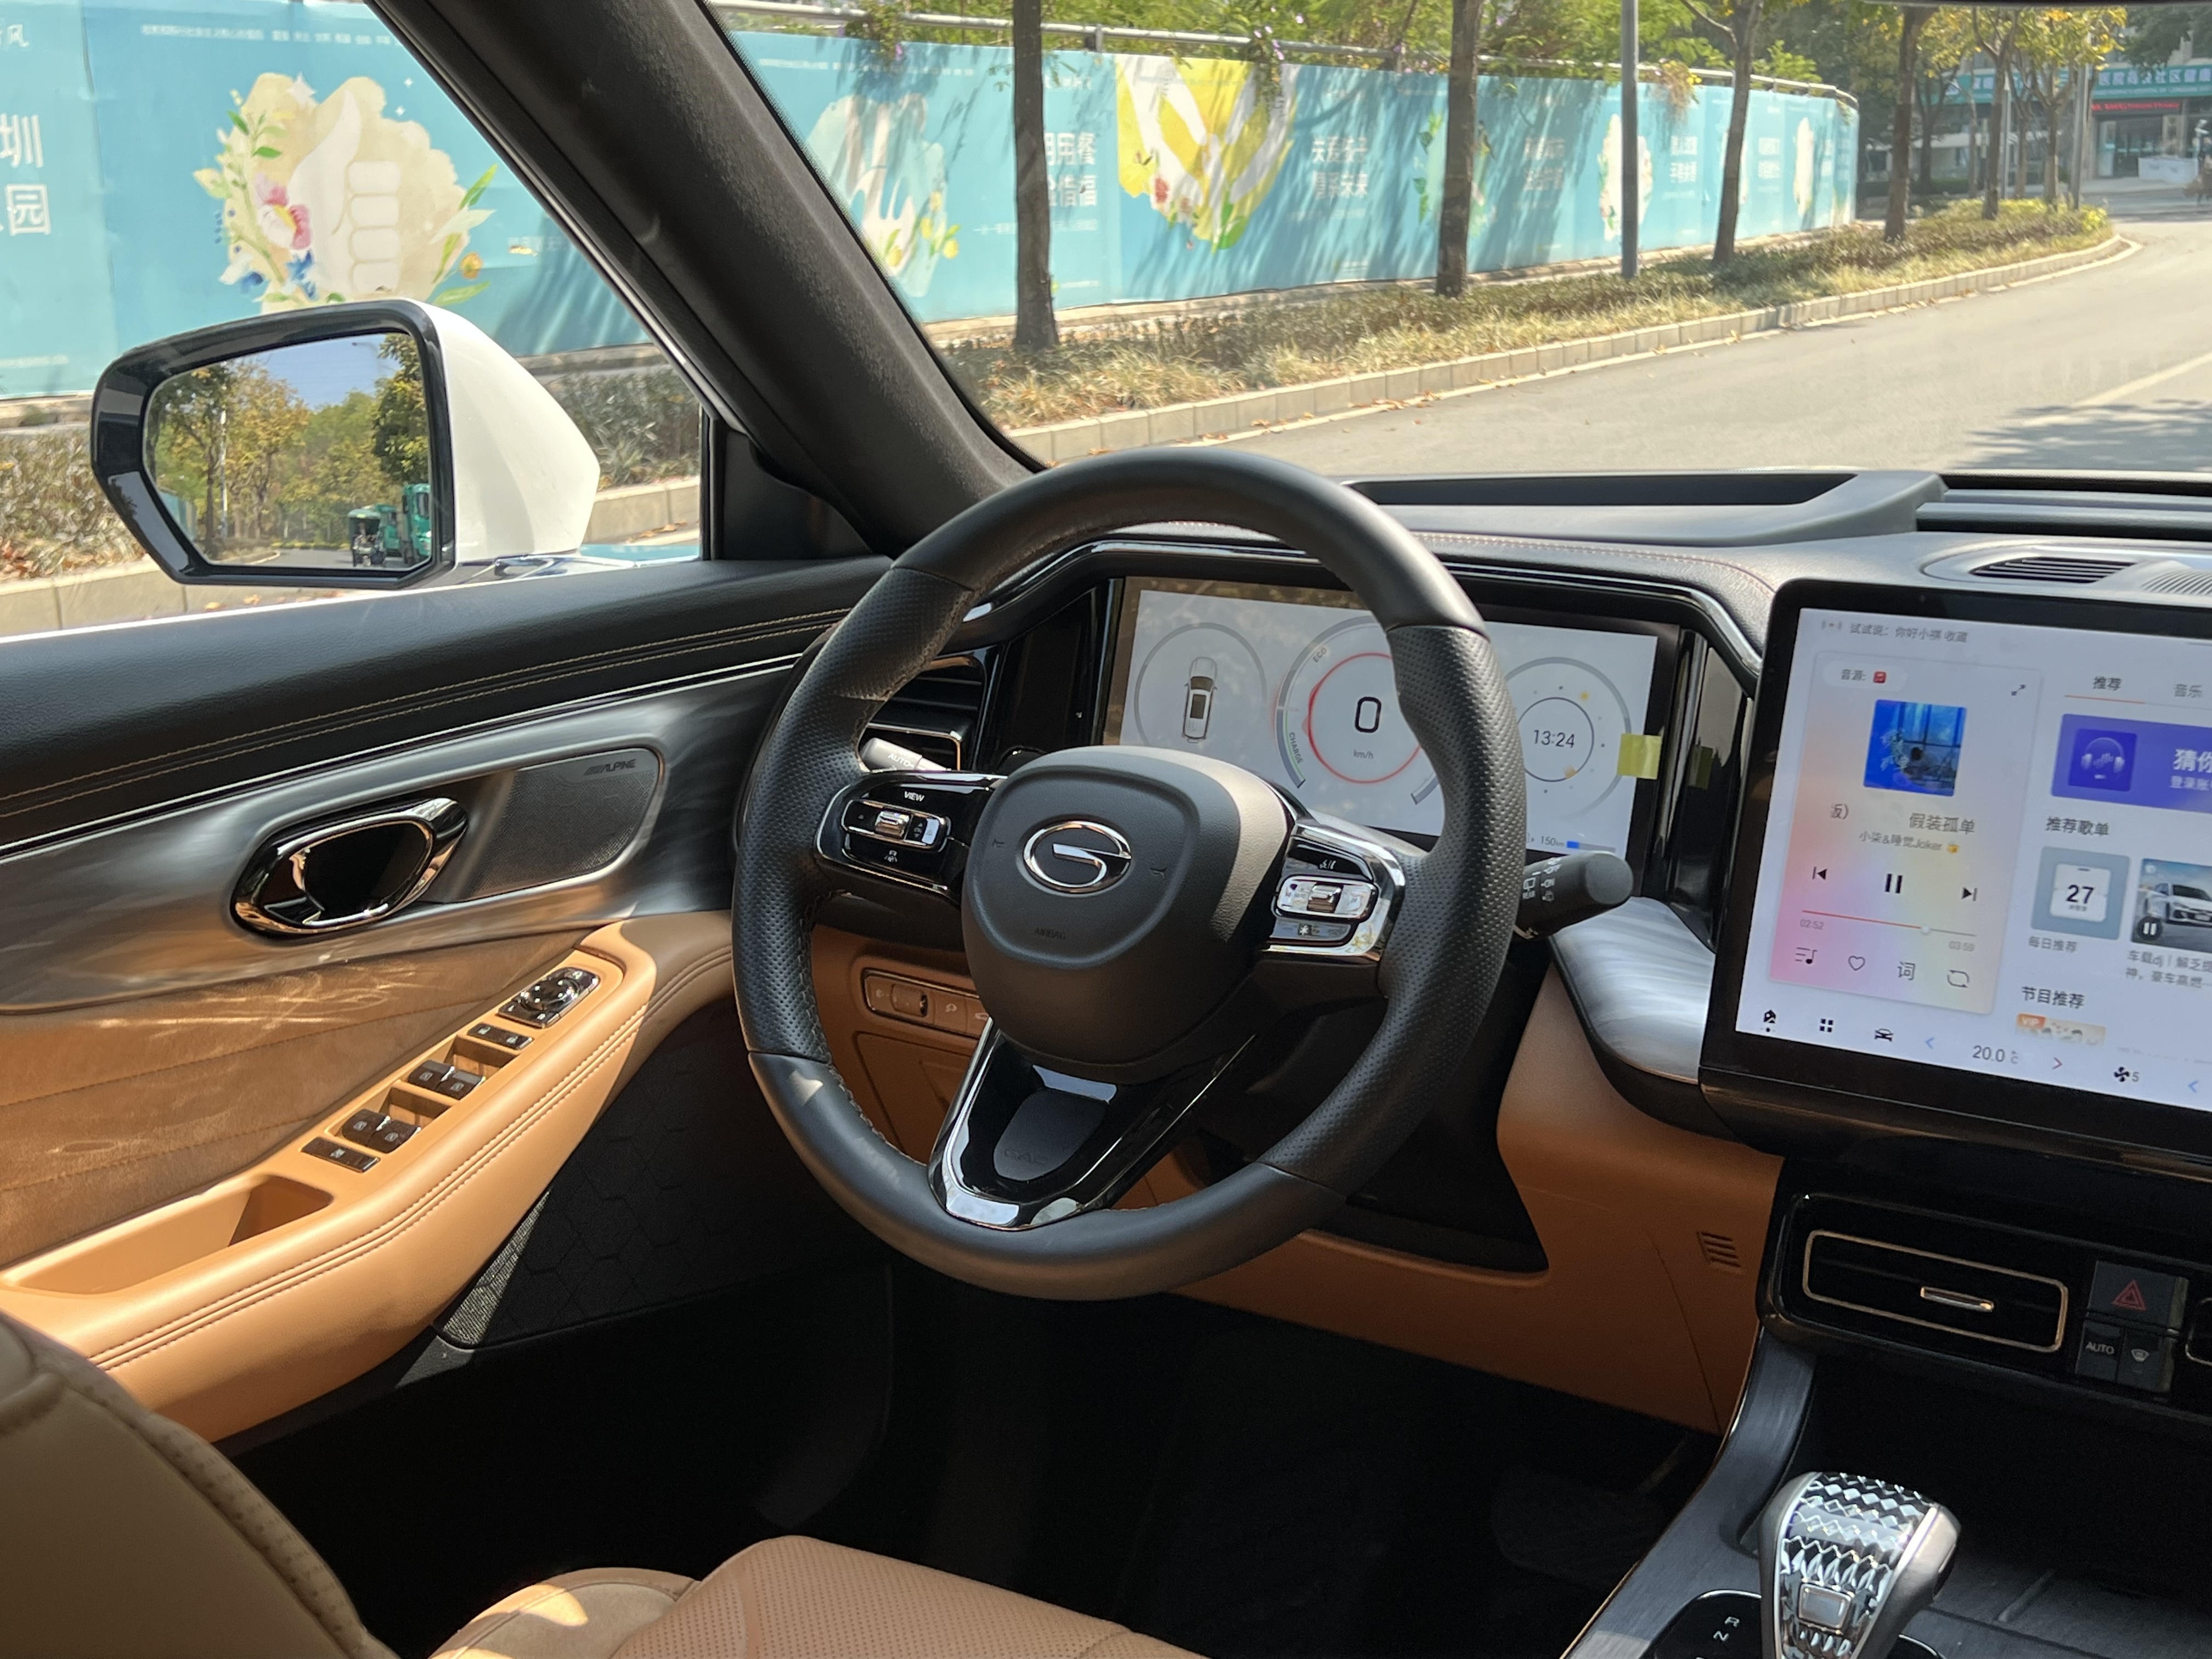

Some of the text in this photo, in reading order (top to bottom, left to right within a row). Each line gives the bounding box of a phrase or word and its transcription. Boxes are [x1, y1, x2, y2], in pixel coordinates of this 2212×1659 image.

[7, 24, 30, 47] 风
[6, 183, 51, 236] 园
[1313, 647, 1327, 663] ECO
[2093, 676, 2122, 691] 推荐
[2174, 684, 2203, 698] 音乐
[1355, 696, 1381, 733] 0
[1534, 730, 1575, 748] 13:24
[1289, 732, 1304, 764] CHARGE
[1353, 749, 1374, 759] km/h
[887, 753, 910, 767] AUTO
[904, 791, 925, 802] VIEW
[1909, 812, 1975, 834] 假装孤单
[2046, 816, 2110, 836] 推荐歌单
[2066, 884, 2096, 905] 27
[1799, 918, 1824, 930] 02:52
[2028, 936, 2078, 953] 每日推荐
[1897, 961, 1916, 981] 词
[2022, 986, 2085, 1009] 节目推荐
[2022, 1016, 2040, 1026] VIP
[1972, 1045, 2006, 1063] 20.0
[2131, 1071, 2140, 1082] 5
[2085, 1341, 2115, 1355] AUTO
